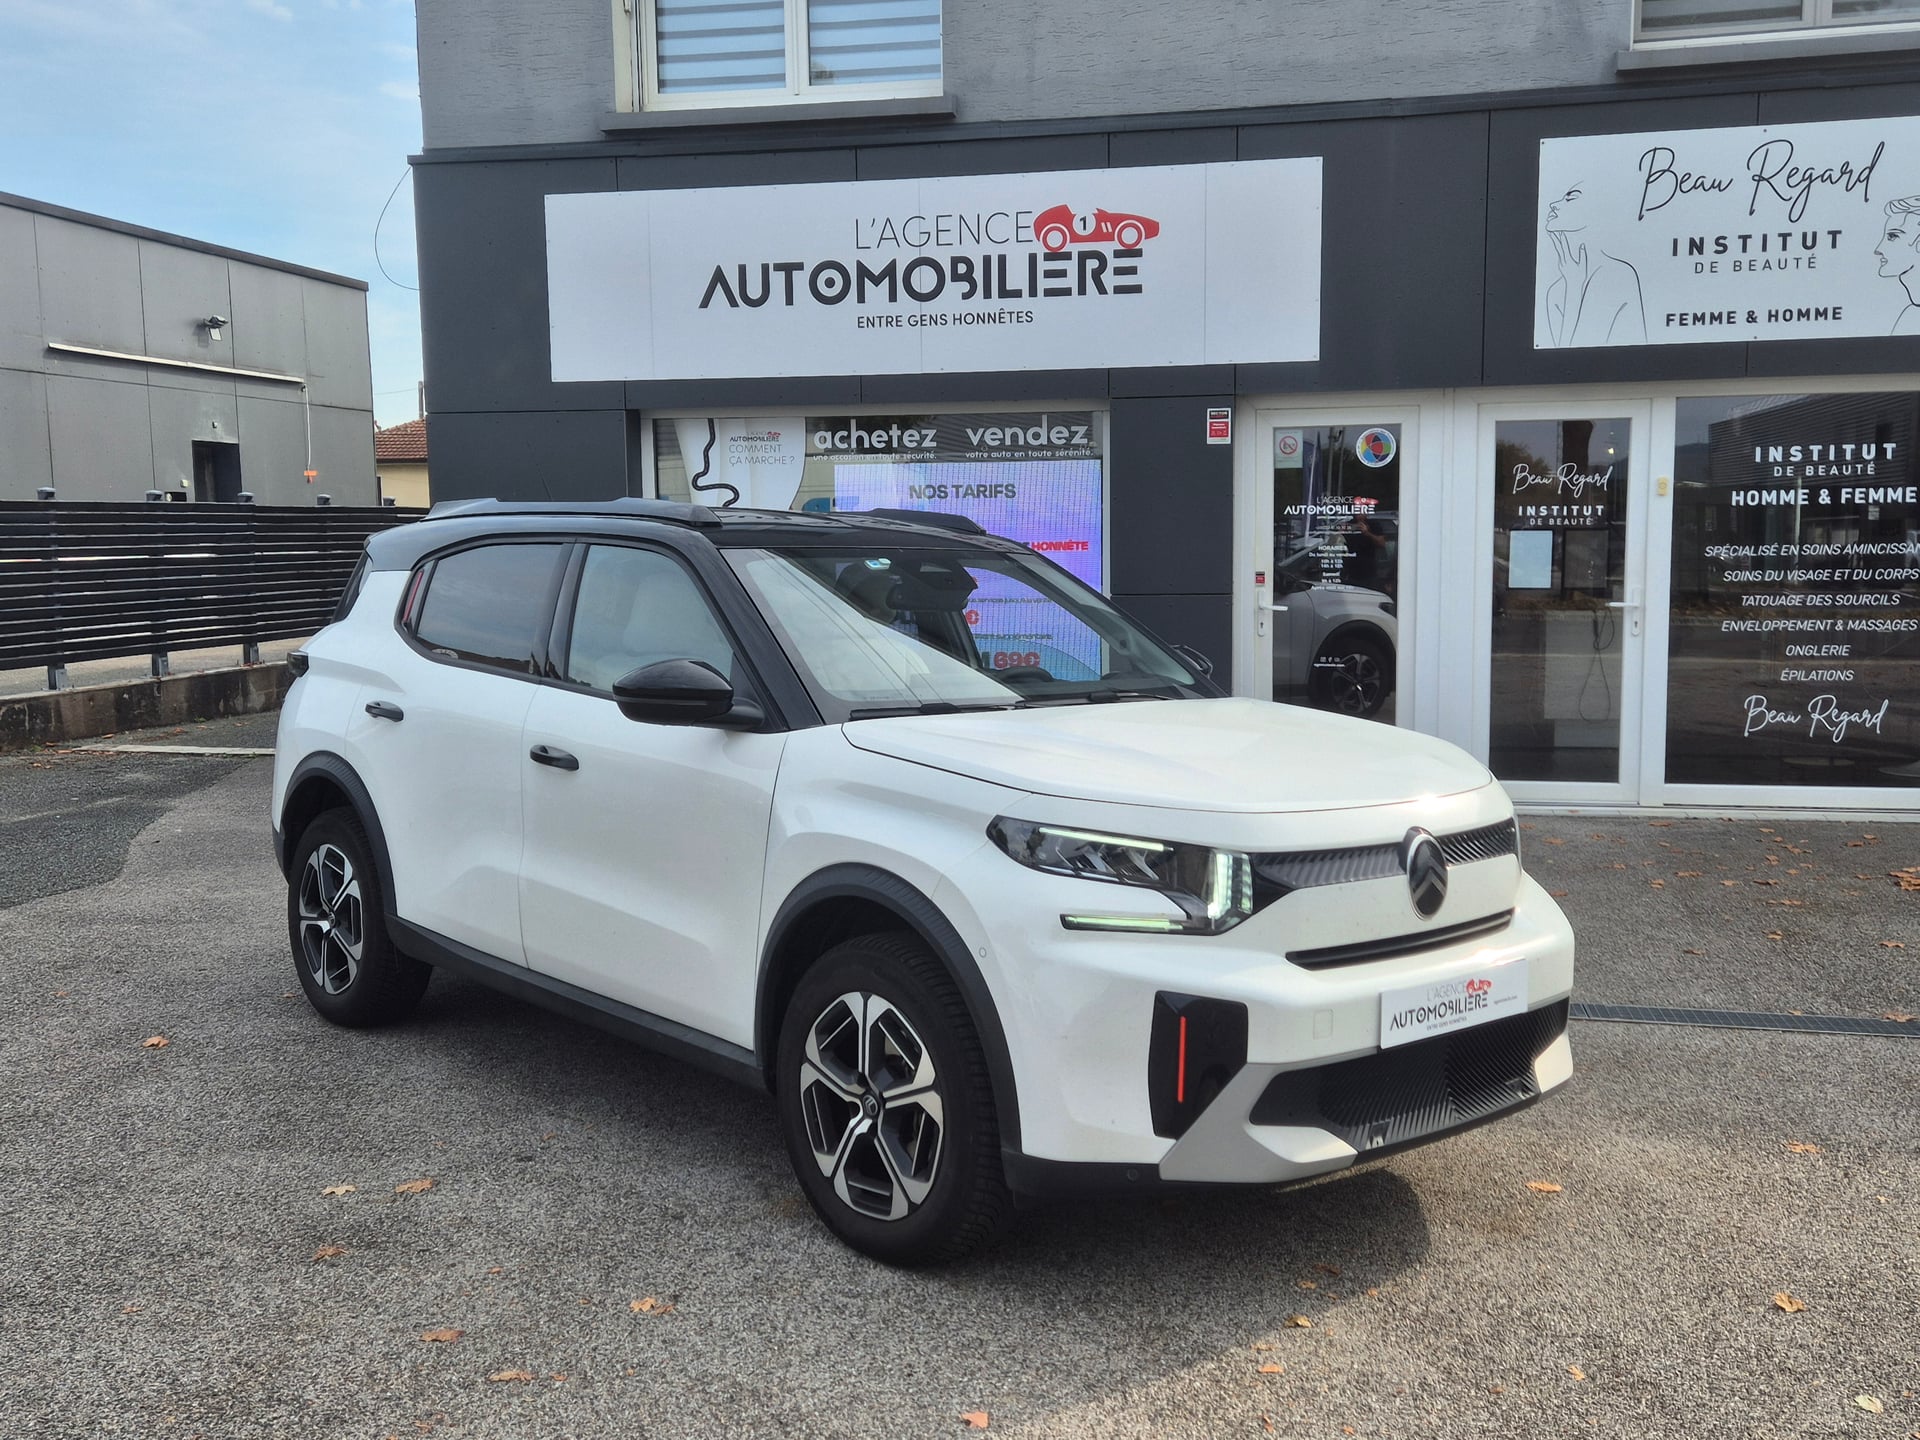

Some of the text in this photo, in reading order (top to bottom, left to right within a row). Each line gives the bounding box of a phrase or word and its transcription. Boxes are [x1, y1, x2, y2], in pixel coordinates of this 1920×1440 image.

[1638, 139, 1885, 223] Beau Regard
[855, 210, 1034, 250] L'AGENCE
[1079, 215, 1087, 231] 1
[1671, 229, 1843, 257] INSTITUT
[1694, 252, 1817, 274] DE BEAUTÉ
[856, 307, 1034, 329] ENTRE GENS HONNÊTES
[1665, 306, 1843, 327] FEMME & HOMME
[813, 418, 937, 449] achetez
[965, 413, 1089, 447] vendez
[728, 444, 783, 454] COMMENT
[964, 450, 989, 459] votre
[990, 450, 1012, 458] auto
[1027, 449, 1052, 458] toute
[1755, 442, 1897, 463] INSTITUT
[728, 455, 796, 467] ÇA MARCHE ?
[1773, 462, 1876, 477] DE BEAUTÉ
[1512, 462, 1614, 498] Beau Regard
[909, 483, 1017, 500] NOS TARIFS
[1731, 486, 1918, 506] HOMME & FEMME
[1518, 504, 1605, 517] INSTITUT
[1529, 516, 1592, 526] DE BEAUTÉ
[1704, 542, 1779, 557] SPÉCIALISÉ
[1780, 545, 1800, 556] EN
[1801, 543, 1843, 556] SOINS
[1722, 568, 1920, 582] SOINS DU VISAGE ET DU CORPS
[1741, 593, 1901, 607] TATOUAGE DES SOURCILS
[1721, 618, 1919, 632] ENVELOPPEMENT & MASSAGES
[1785, 644, 1852, 657] ONGLERIE
[1779, 668, 1855, 682] ÉPILATIONS
[1743, 694, 1889, 743] Beau Regard
